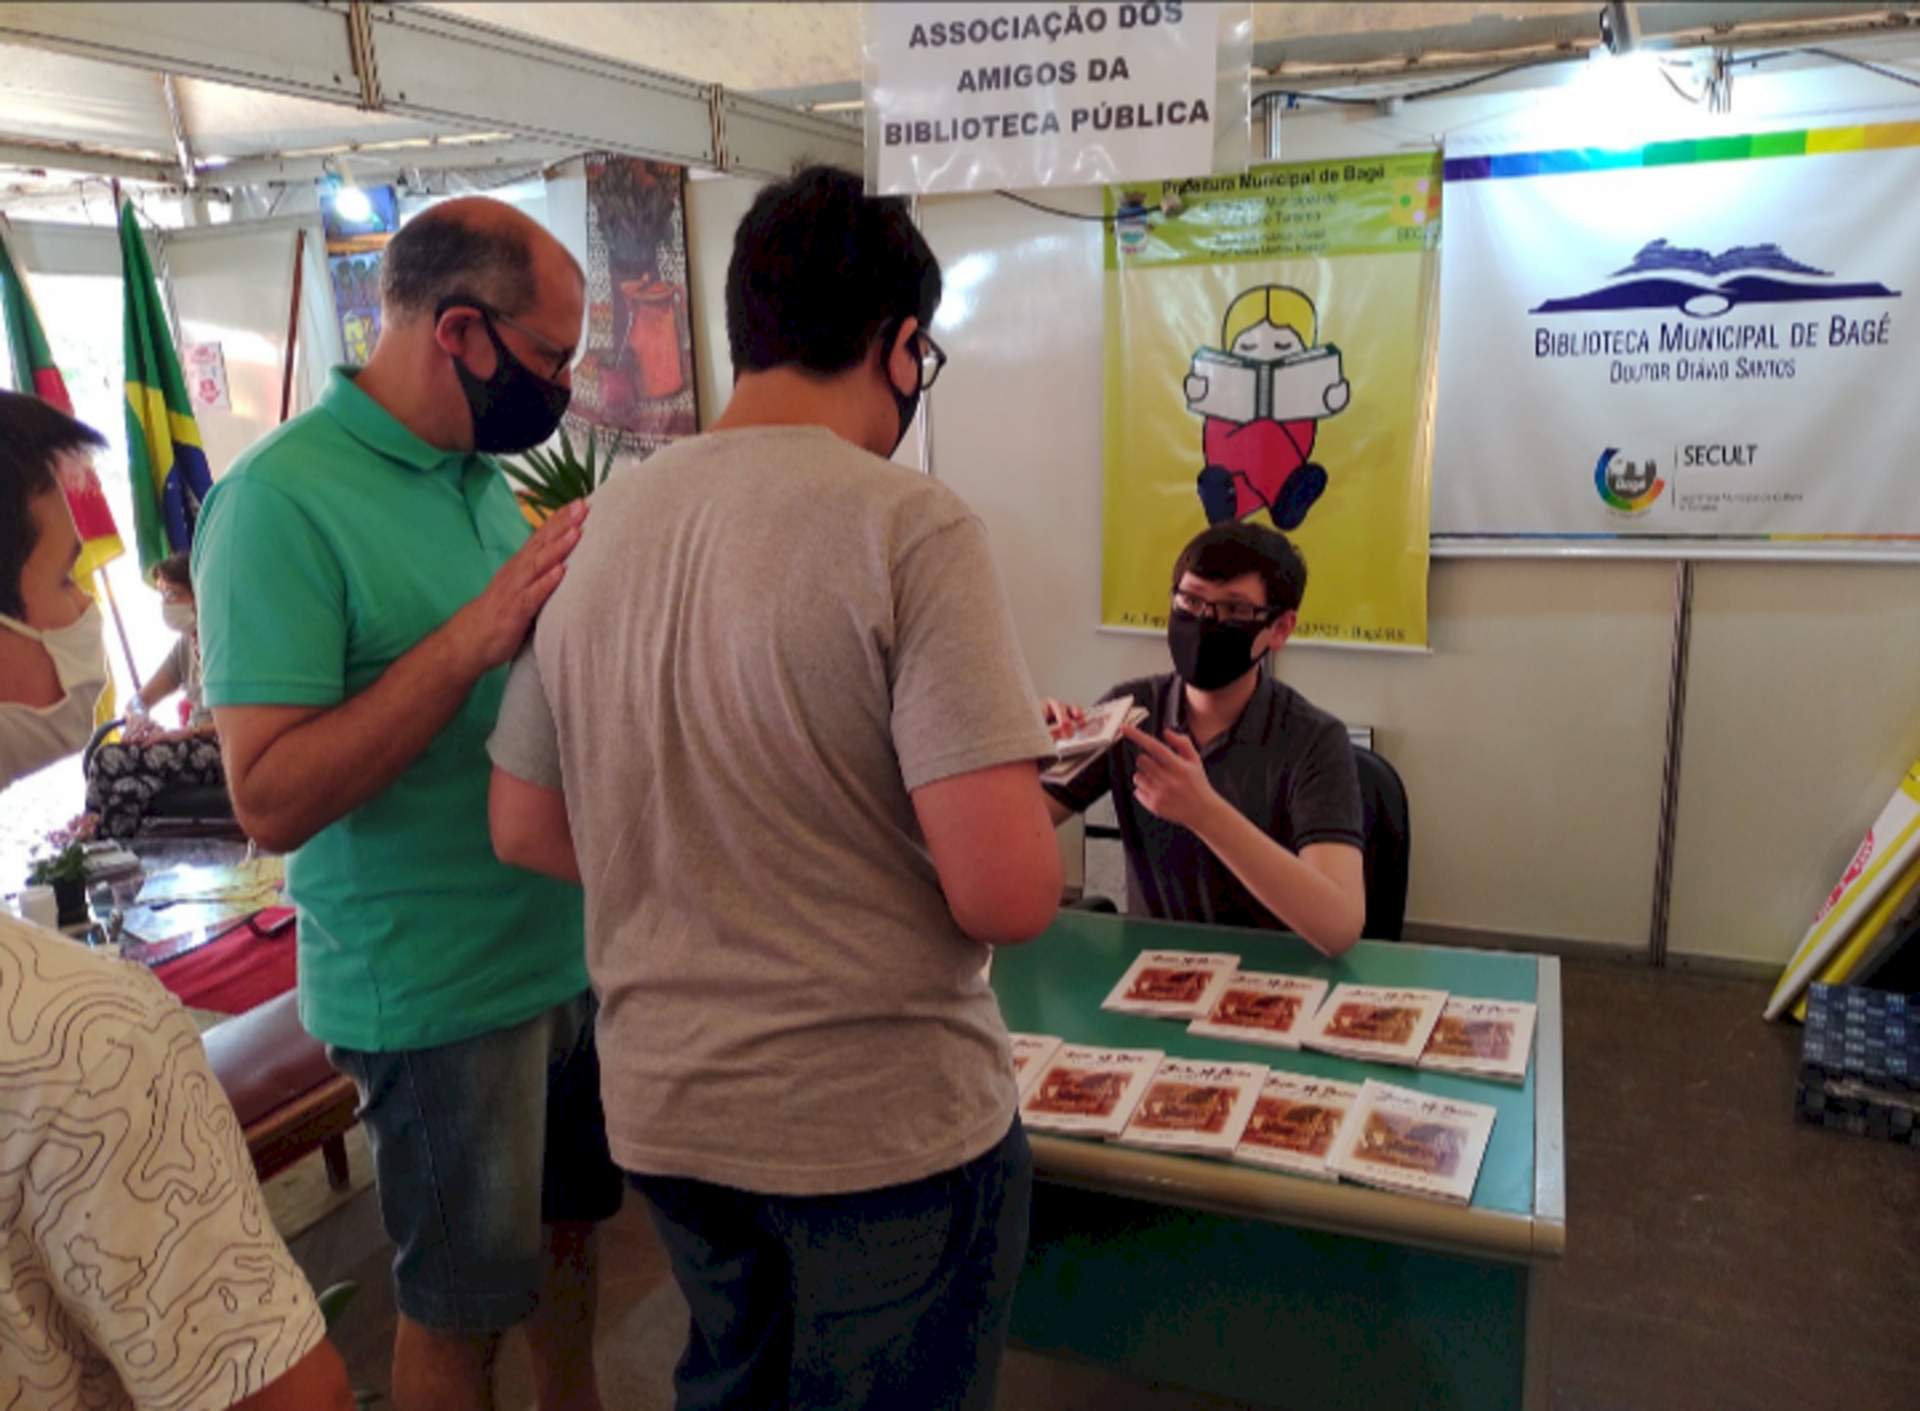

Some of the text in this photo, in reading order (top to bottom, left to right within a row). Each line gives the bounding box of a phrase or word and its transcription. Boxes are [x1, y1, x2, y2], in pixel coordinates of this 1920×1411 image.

[909, 1, 1184, 48] ASSOCIAÇÃO DOS
[957, 57, 1130, 93] AMIGOS DA
[885, 99, 1210, 147] BIBLIOTECA PÚBLICA
[1239, 169, 1315, 191] Municipal
[1320, 168, 1339, 183] de
[1683, 444, 1758, 466] SECULT
